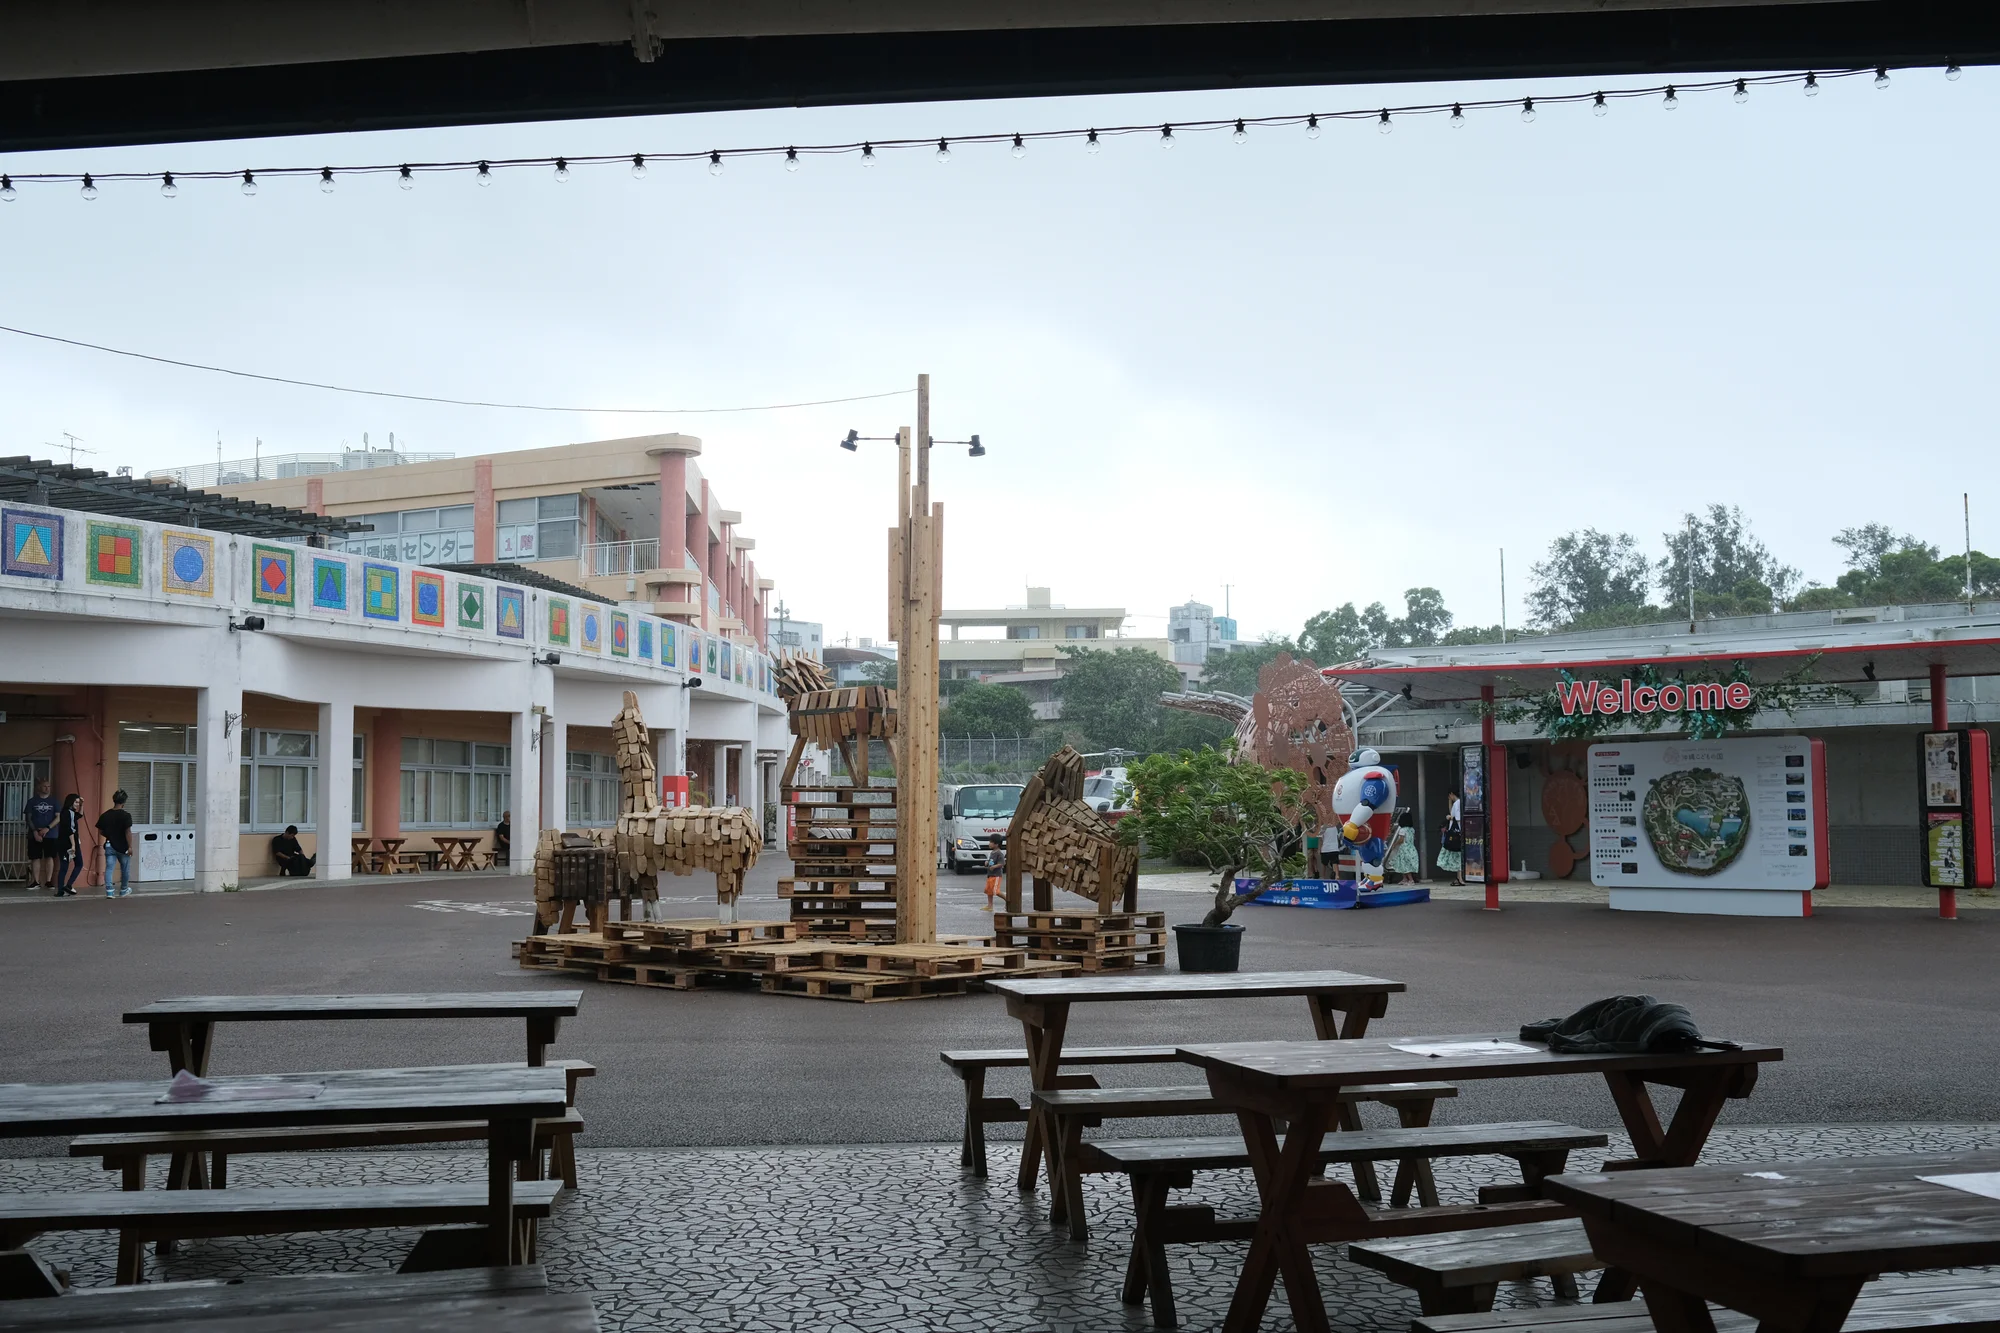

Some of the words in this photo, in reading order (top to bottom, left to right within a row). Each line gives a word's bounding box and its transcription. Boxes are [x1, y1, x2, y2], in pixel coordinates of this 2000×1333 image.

[337, 538, 474, 562] 環境センター
[1555, 678, 1752, 716] Welcome
[1322, 882, 1340, 894] JIP
